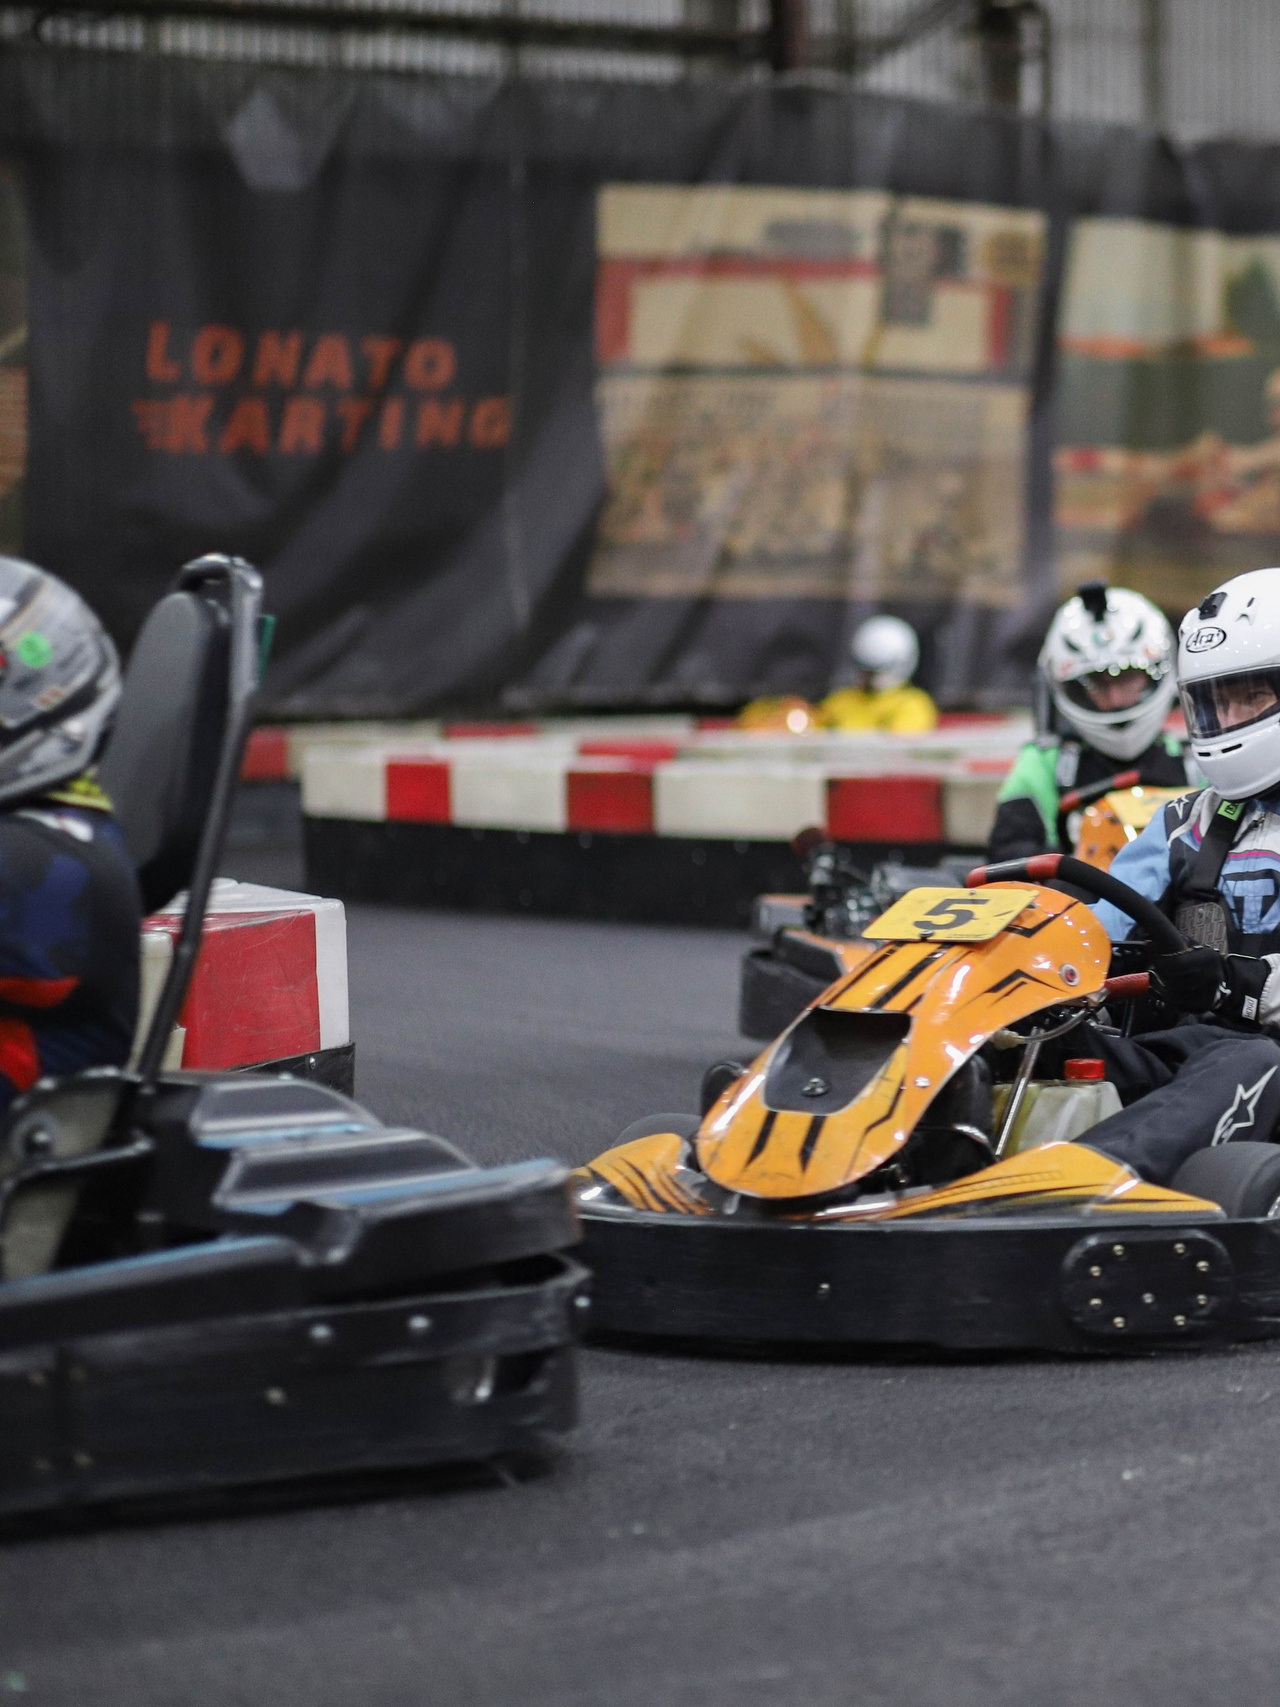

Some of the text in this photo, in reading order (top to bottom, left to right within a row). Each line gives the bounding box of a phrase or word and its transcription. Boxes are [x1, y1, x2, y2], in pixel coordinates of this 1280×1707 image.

[146, 320, 458, 390] LONATO
[150, 394, 514, 456] KARTING
[913, 898, 991, 931] 5
